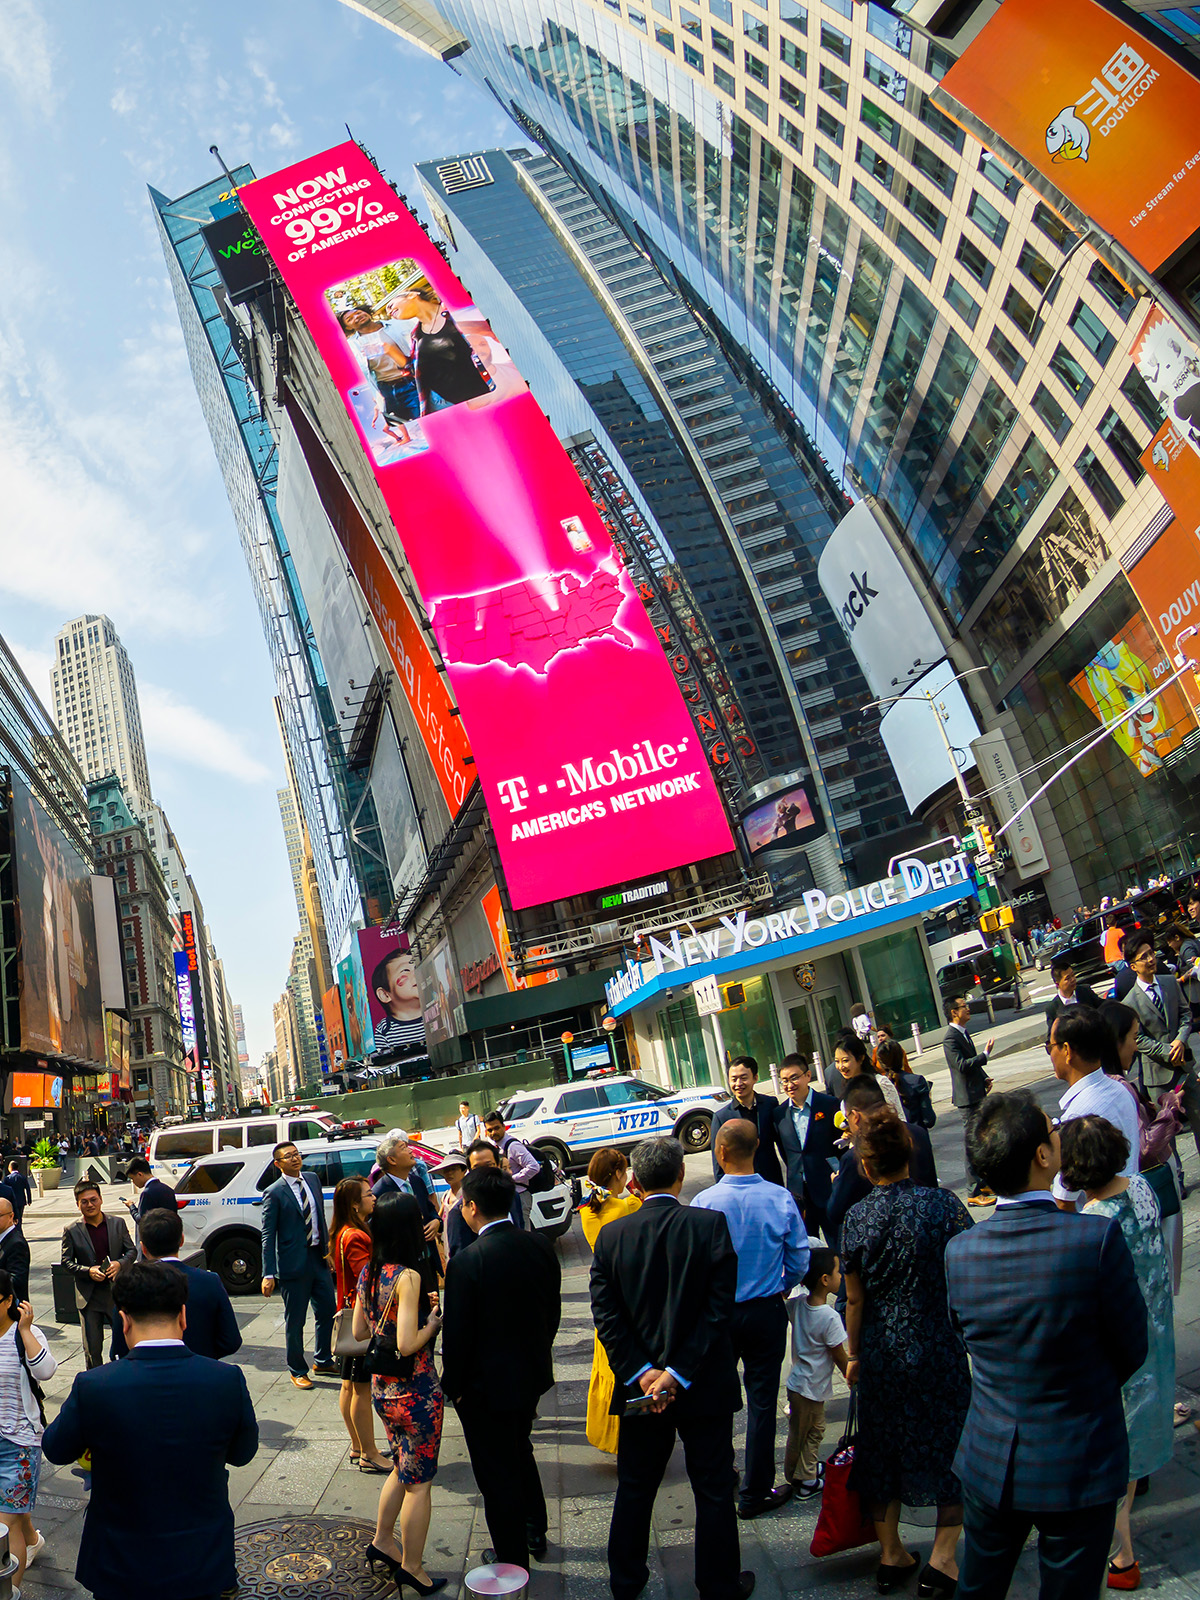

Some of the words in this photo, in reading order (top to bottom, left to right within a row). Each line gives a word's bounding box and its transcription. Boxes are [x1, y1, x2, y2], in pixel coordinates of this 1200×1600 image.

[1098, 68, 1160, 137] DOUYU.COM
[270, 178, 371, 226] CONNECTING
[272, 166, 347, 210] NOW
[1129, 208, 1148, 228] Live
[1145, 179, 1175, 212] Stream
[1173, 167, 1187, 184] for
[284, 196, 383, 246] 99%
[287, 248, 307, 263] OF
[311, 211, 400, 255] AMERICANS
[364, 562, 415, 697] Nasdaq
[415, 674, 467, 807] Listed
[657, 624, 730, 765] YOUNG
[510, 802, 607, 841] AMERICA'S
[611, 771, 701, 814] NETWORK
[183, 913, 195, 949] Locker
[649, 929, 721, 974] NEW
[719, 909, 804, 955] YORK
[802, 888, 898, 931] POLICE
[898, 852, 971, 899] DEPT
[187, 948, 198, 971] Foot
[177, 973, 196, 1050] 212-645-7575
[618, 1110, 659, 1131] NYPD
